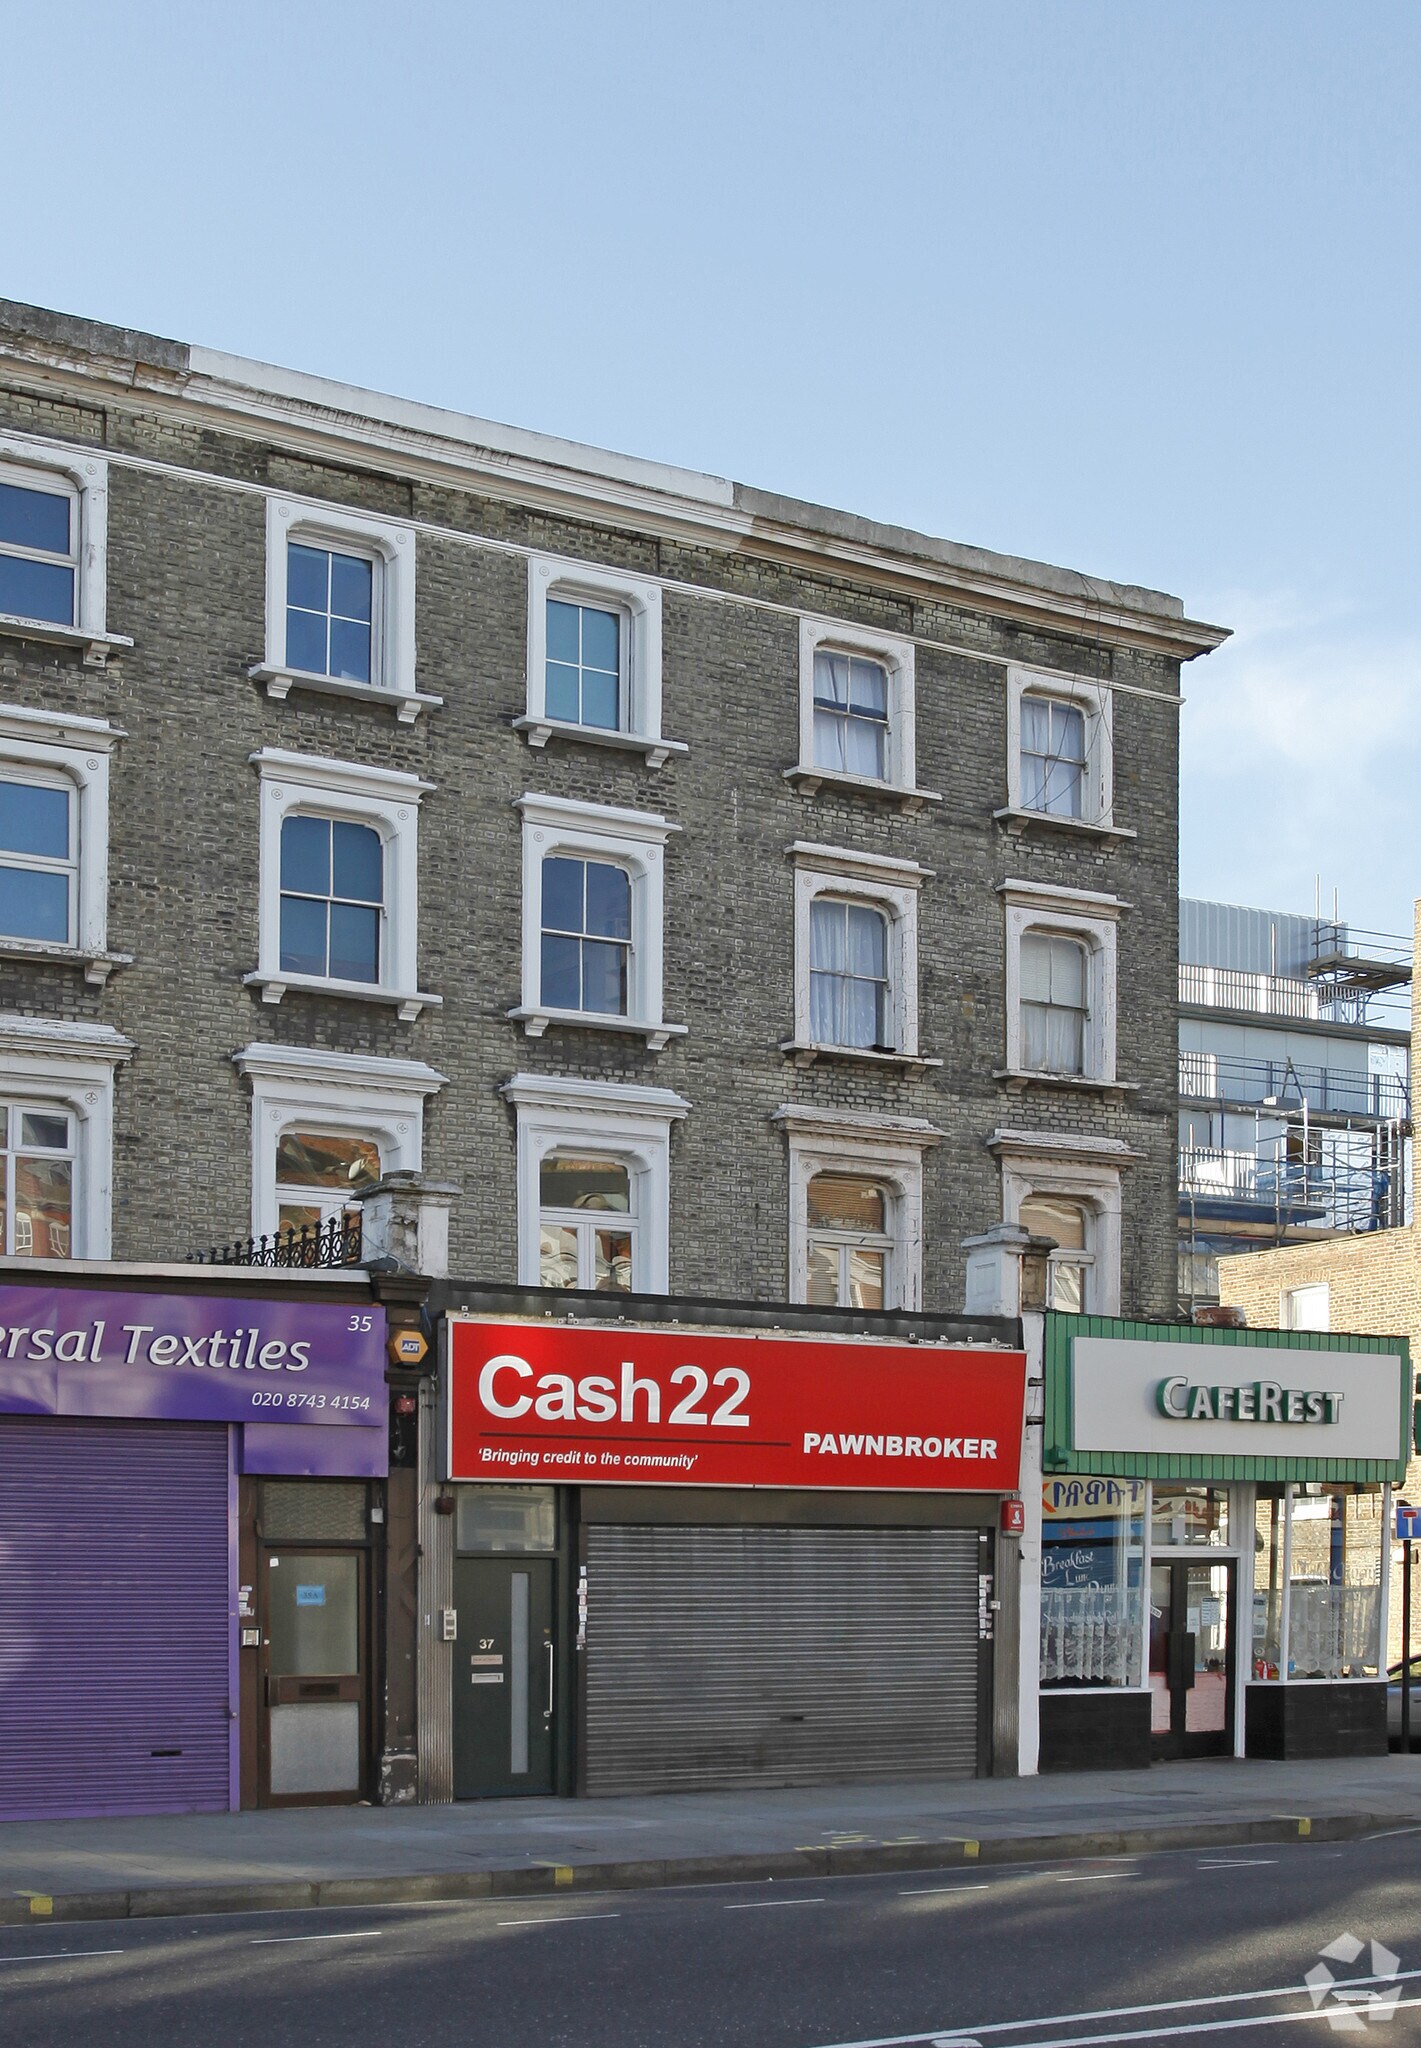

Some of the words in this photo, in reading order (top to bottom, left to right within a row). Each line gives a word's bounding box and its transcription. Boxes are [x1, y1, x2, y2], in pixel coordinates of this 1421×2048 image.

[347, 1315, 373, 1332] 35
[0, 1320, 106, 1363] rsal
[122, 1325, 312, 1371] Textiles
[402, 1342, 420, 1352] ADT
[251, 1392, 283, 1408] 020
[286, 1393, 327, 1409] 8743
[330, 1395, 371, 1411] 4154
[803, 1433, 998, 1460] PAWNBROKER
[542, 1450, 581, 1465] credit
[584, 1452, 597, 1465] to
[600, 1452, 621, 1466] the
[1041, 1550, 1094, 1577] Breakfast
[479, 1638, 495, 1650] 37
